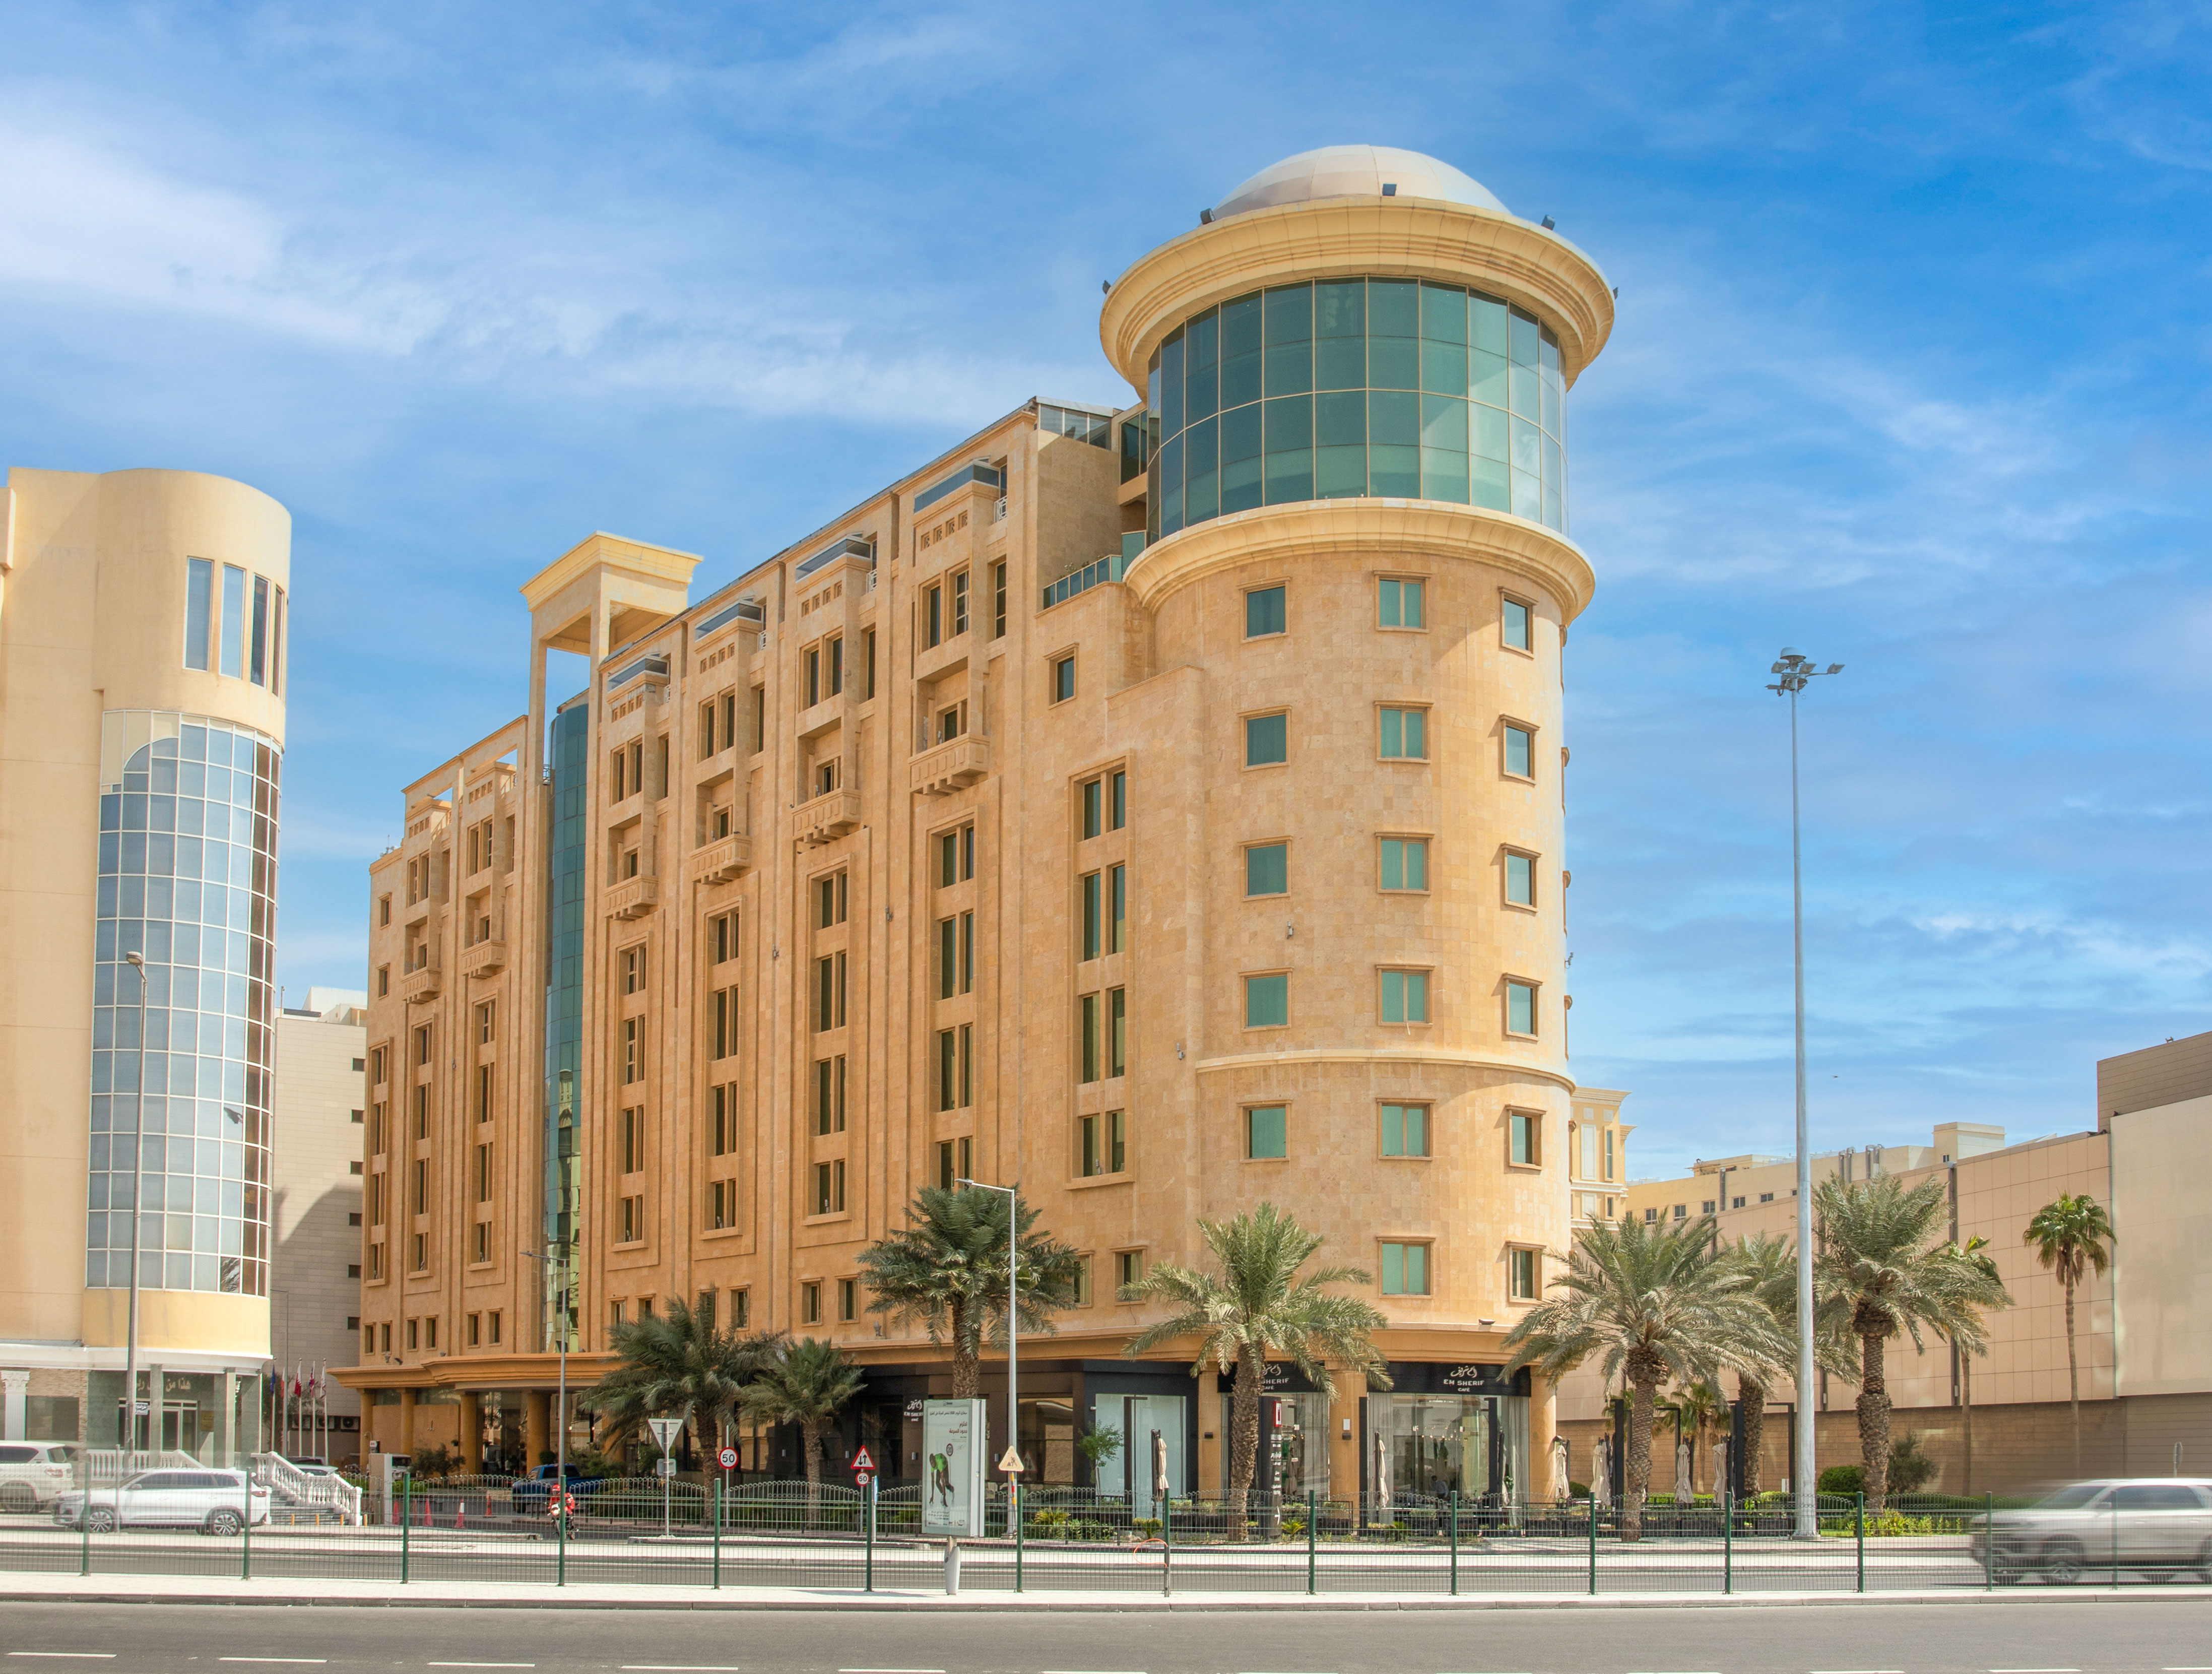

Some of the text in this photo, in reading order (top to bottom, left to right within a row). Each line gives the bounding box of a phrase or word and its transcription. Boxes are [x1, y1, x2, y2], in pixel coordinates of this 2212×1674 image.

[165, 1378, 176, 1392] من
[178, 1377, 191, 1390] هذا
[722, 1454, 735, 1463] 50
